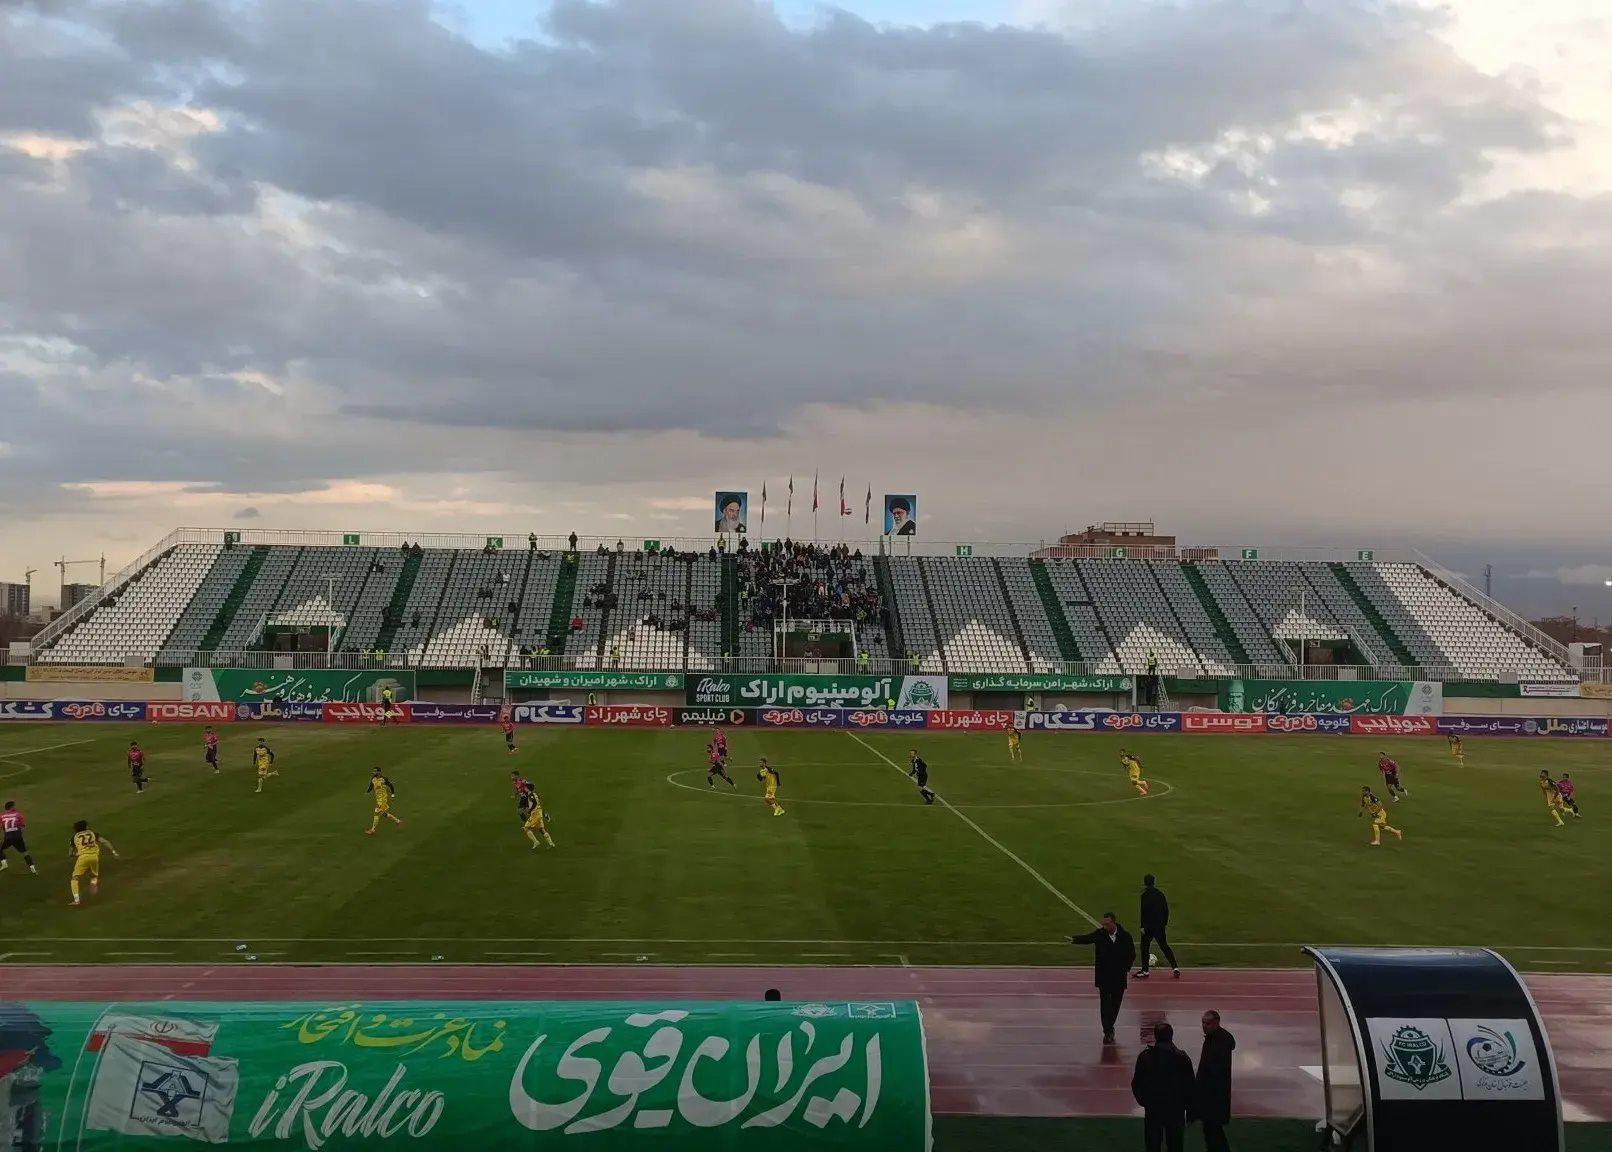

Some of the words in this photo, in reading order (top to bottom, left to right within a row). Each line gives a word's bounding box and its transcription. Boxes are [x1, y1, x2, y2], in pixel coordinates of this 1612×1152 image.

[349, 535, 355, 544] L
[490, 538, 497, 547] K
[960, 546, 968, 555] H
[1116, 548, 1123, 556] G
[1246, 550, 1252, 559] F
[1363, 552, 1369, 560] E
[240, 675, 295, 698] هنر
[520, 675, 561, 687] شهیدان
[563, 678, 568, 686] و
[570, 675, 604, 687] امیران
[605, 675, 627, 687] شهر
[696, 677, 730, 693] iRalco
[972, 677, 1004, 690] گذاری
[1006, 678, 1042, 690] سرمایه
[1043, 678, 1060, 689] امن
[1061, 678, 1088, 690] شهر
[740, 679, 784, 704] اراک
[787, 678, 892, 704] آلومینیوم
[696, 694, 714, 703] SPORT
[714, 694, 730, 703] CLUB
[1370, 684, 1398, 713] اراک
[0, 703, 54, 719] کشکا
[61, 702, 105, 718] نادری
[108, 704, 140, 718] چای
[147, 705, 228, 717] TOSAN
[411, 706, 463, 719] سوفیا
[464, 706, 497, 721] چای
[588, 707, 642, 724] شهرزاد
[643, 707, 668, 723] چای
[681, 708, 726, 724] فیلیمو
[762, 709, 804, 725] نادری
[806, 710, 837, 726] چای
[848, 710, 889, 727] نادری
[889, 712, 924, 726] کلوچه
[931, 711, 984, 728] شهرزاد
[984, 710, 1009, 727] چای
[1102, 714, 1144, 729] نادری
[1146, 715, 1177, 730] چای
[1186, 716, 1263, 729] توسن
[1267, 715, 1318, 731] نادری
[1318, 717, 1350, 730] کلوچه
[1357, 715, 1431, 733] نیوپایپ
[1437, 719, 1489, 731] سوفیا
[1489, 720, 1522, 733] چای
[2, 817, 16, 829] 77
[78, 834, 94, 846] 22
[277, 1004, 363, 1046] افتخار
[354, 1012, 471, 1058] عزت
[509, 1009, 690, 1135] قوی
[677, 1020, 882, 1129] ایران
[248, 1060, 445, 1150] iRalco
